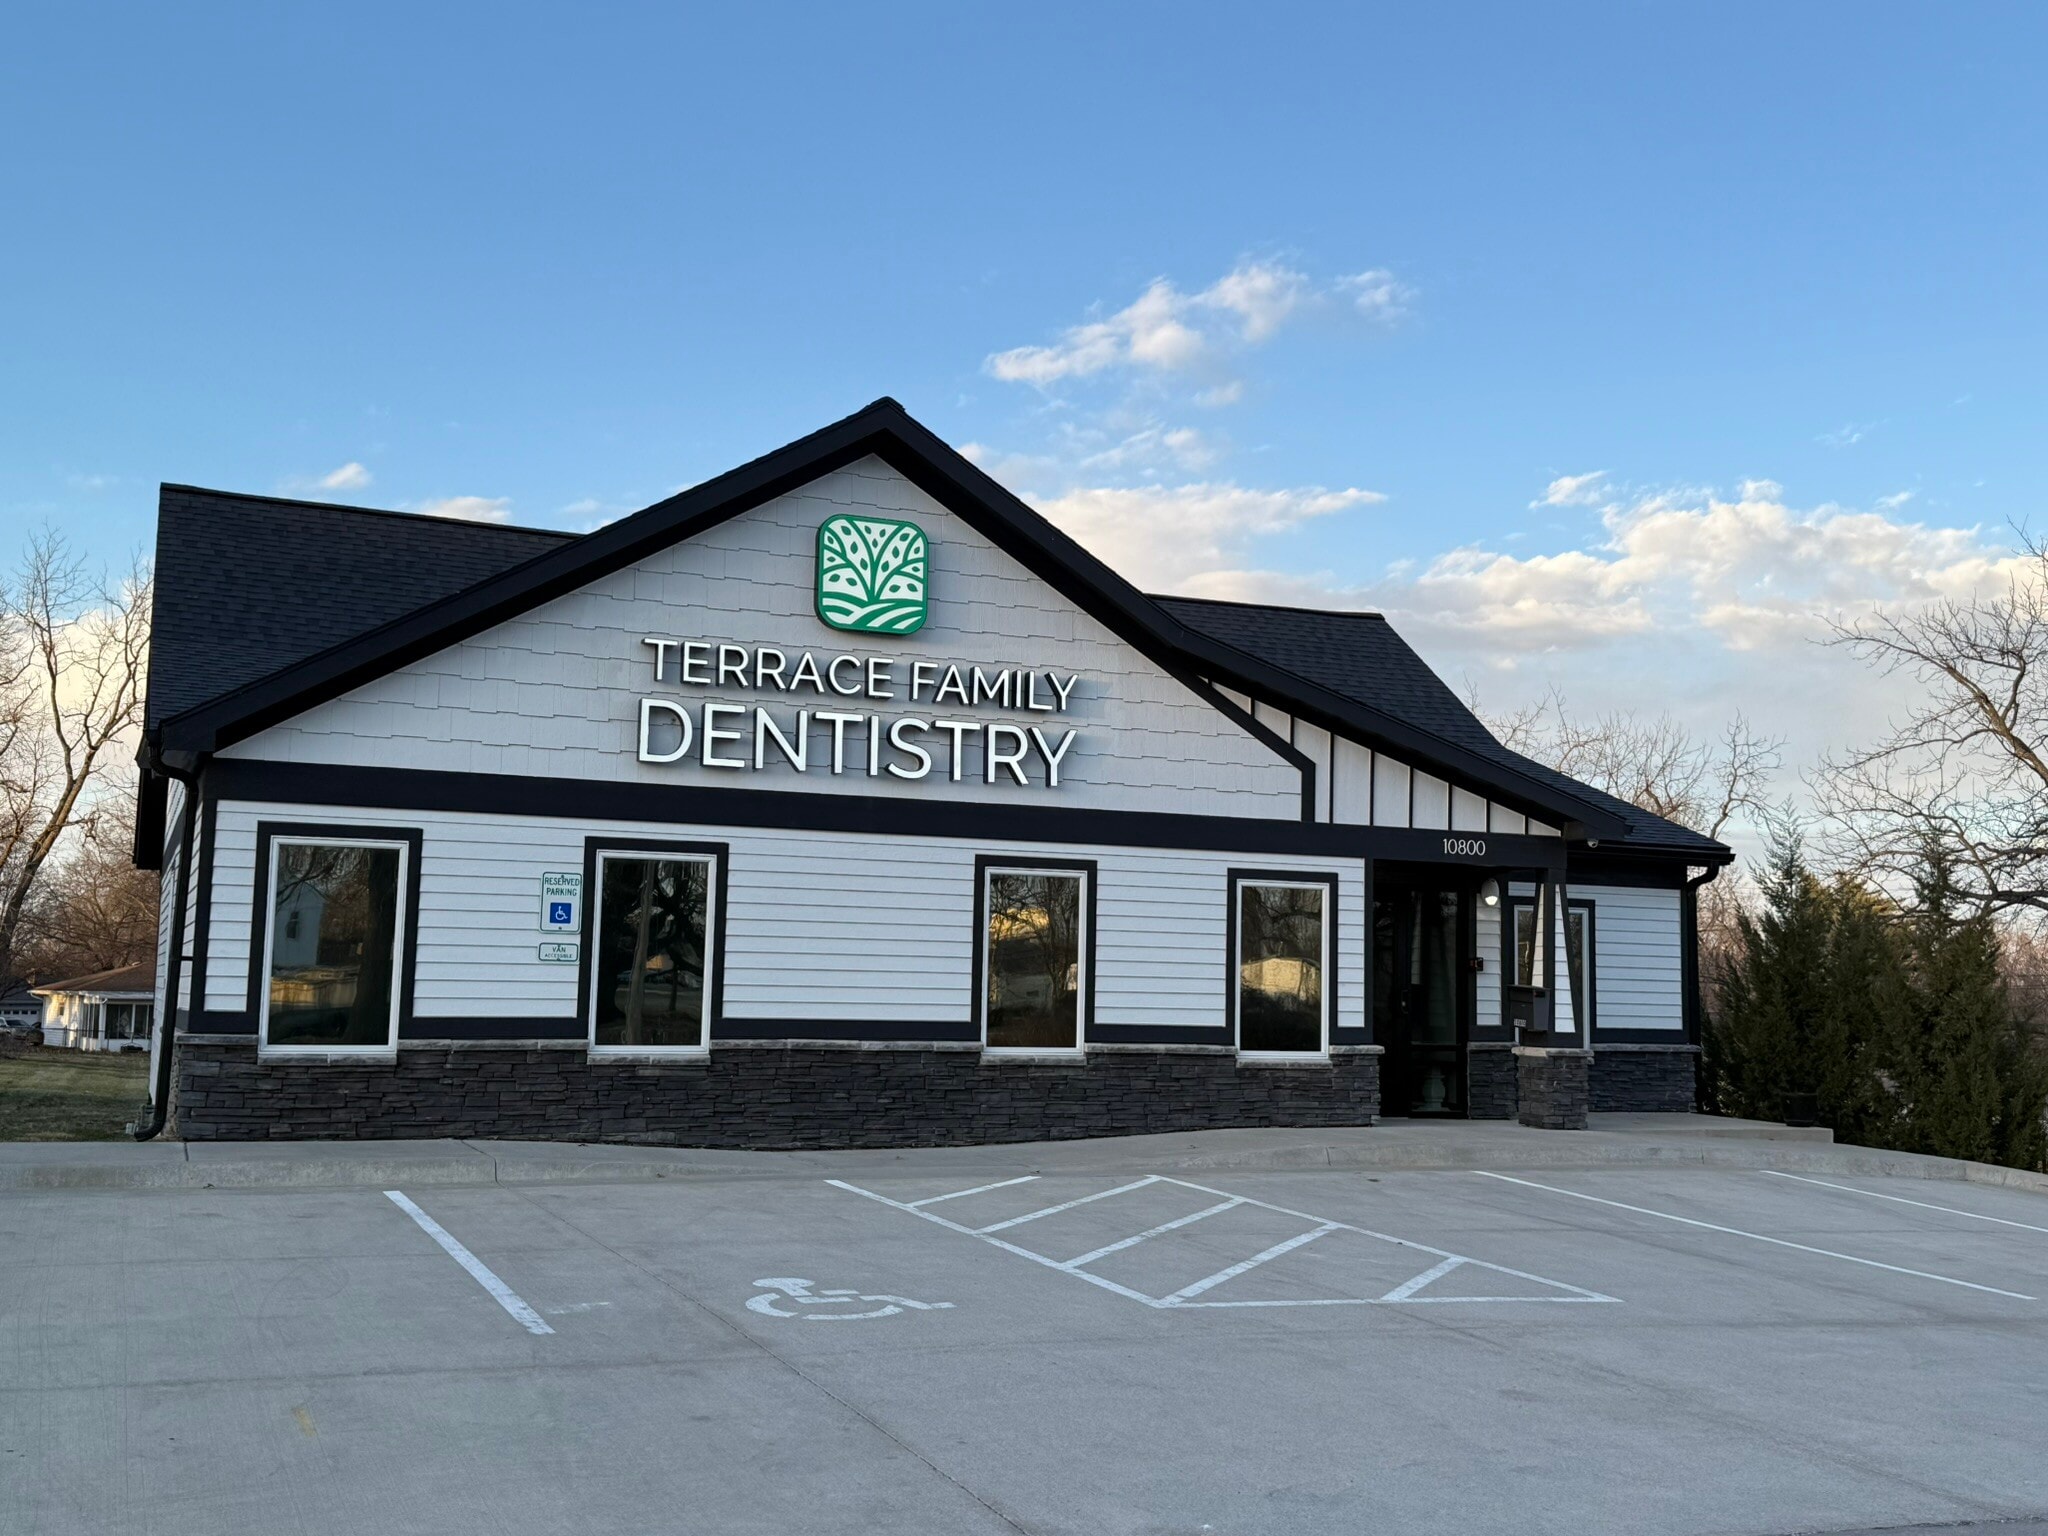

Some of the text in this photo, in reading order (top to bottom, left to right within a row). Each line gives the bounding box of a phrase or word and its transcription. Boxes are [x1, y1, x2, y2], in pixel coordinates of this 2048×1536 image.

[643, 637, 1079, 712] TERRACE FAMILY
[637, 697, 1078, 787] DENTISTRY
[1443, 838, 1486, 856] 10800
[544, 877, 580, 887] RESERVED
[546, 887, 577, 896] PARKING
